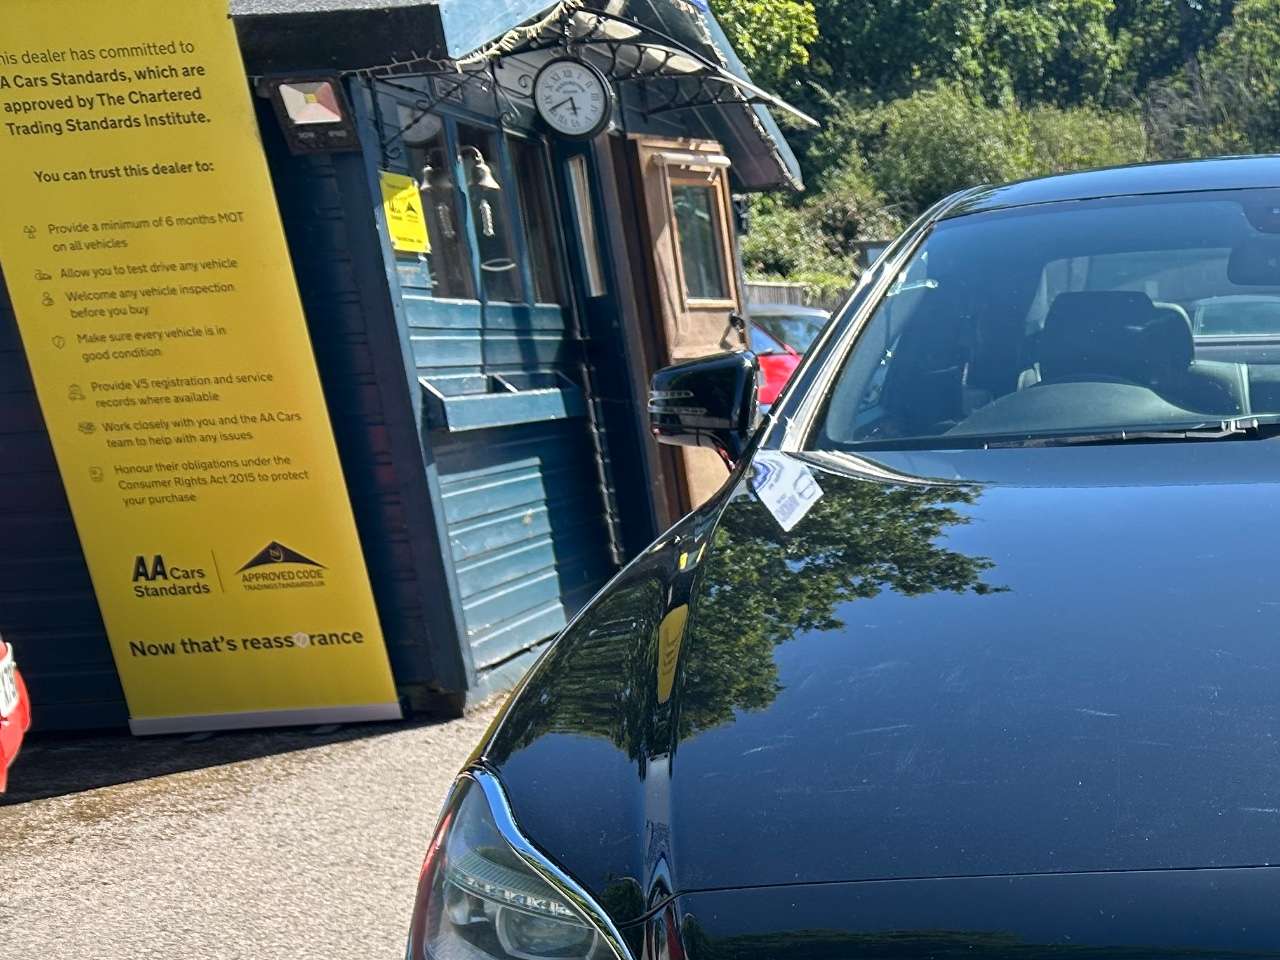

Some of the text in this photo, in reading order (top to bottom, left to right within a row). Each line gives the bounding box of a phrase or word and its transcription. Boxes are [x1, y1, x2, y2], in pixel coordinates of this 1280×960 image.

[22, 49, 66, 64] dealer
[70, 48, 96, 61] has
[99, 42, 176, 60] committed
[179, 41, 195, 54] to
[13, 75, 48, 88] Cars
[52, 69, 132, 86] Standards,
[134, 65, 178, 80] which
[182, 65, 206, 76] are
[4, 87, 201, 114] approved by The Chartered
[6, 111, 211, 136] Trading Standards Institute.
[34, 161, 215, 183] You can trust this dealer to:
[48, 212, 244, 235] Provide a minimum of 6 months MOT
[53, 238, 128, 253] on all vehicles
[60, 258, 238, 279] Allow you to test drive any vehicle
[66, 283, 234, 302] Welcome any vehicle inspection
[71, 304, 149, 319] before you buy
[77, 326, 226, 344] Make sure every vehicle is in
[82, 347, 161, 362] good condition
[91, 373, 273, 392] Provide V5 registration and service
[96, 392, 219, 408] records where available
[102, 411, 302, 432] Work closely with you and the AA Cars
[106, 431, 253, 448] team to help with any issues
[113, 455, 290, 475] Honour their obligations under the
[118, 470, 309, 490] Consumer Rights Act 2015 to protect
[123, 492, 197, 507] your purchase
[132, 554, 205, 582] AA Cars
[241, 569, 324, 582] APPROVED CODE
[133, 582, 210, 598] Standards
[129, 640, 176, 657] Now
[180, 635, 237, 654] that's
